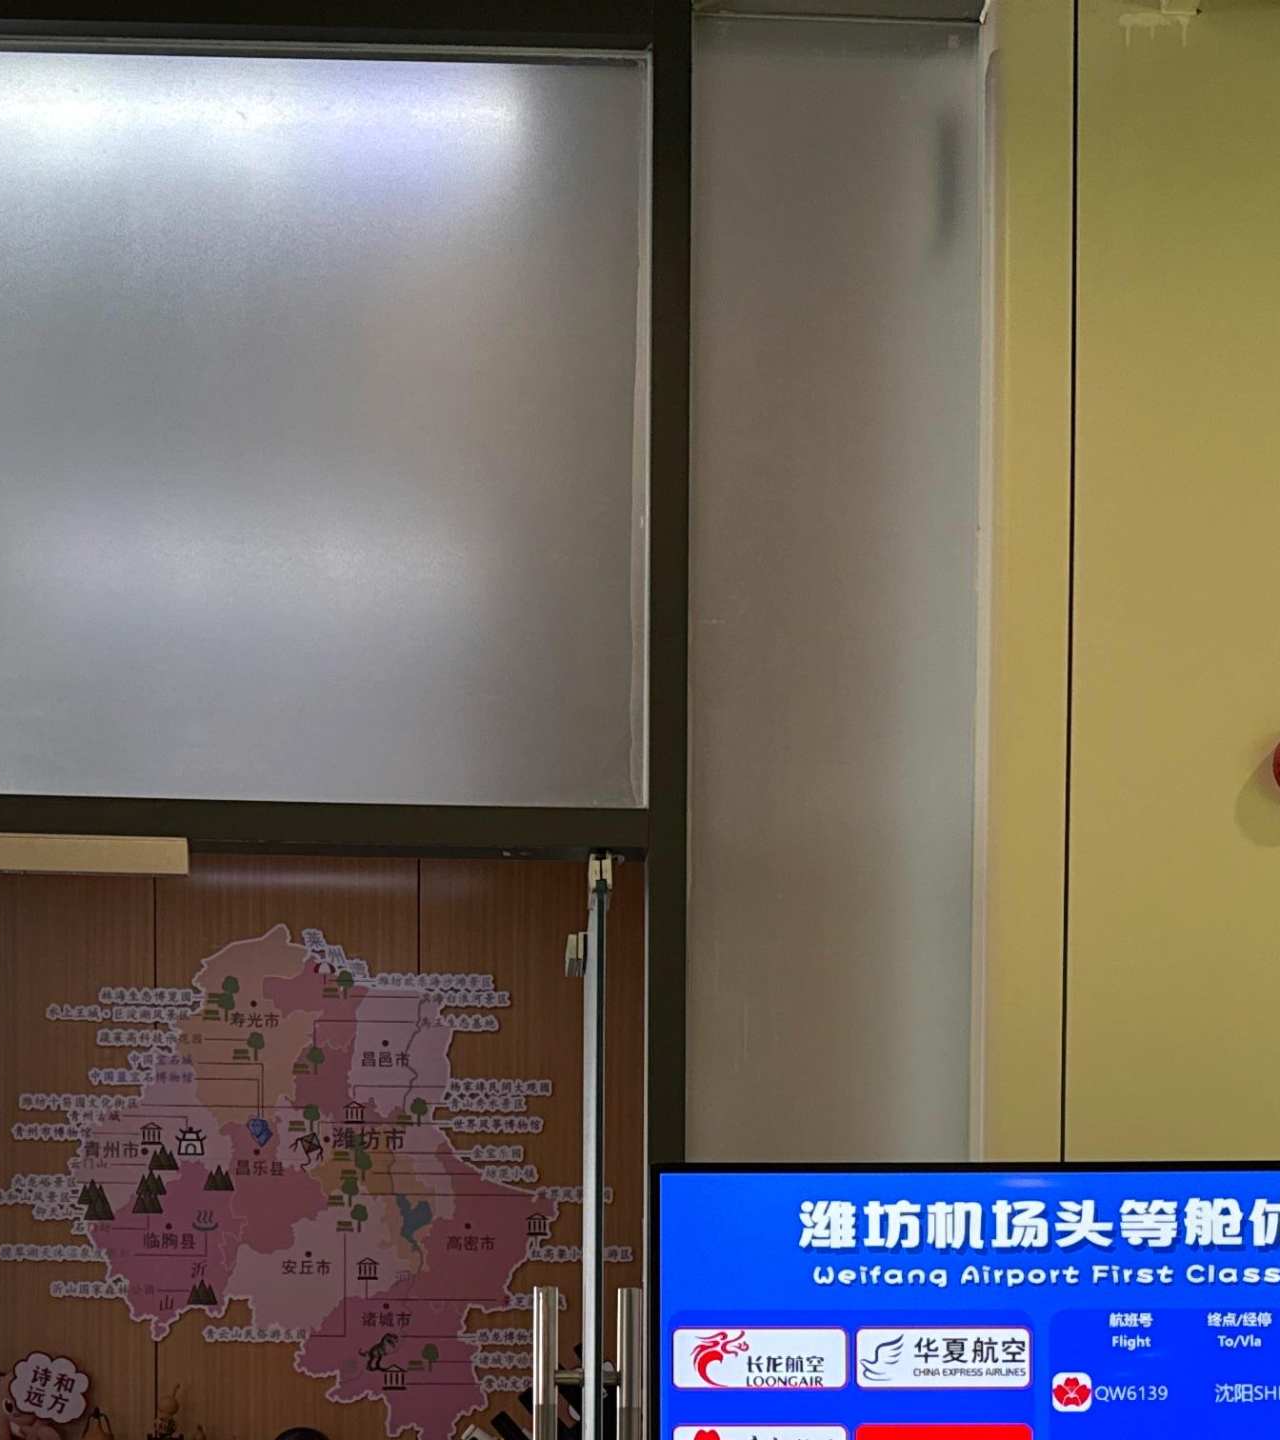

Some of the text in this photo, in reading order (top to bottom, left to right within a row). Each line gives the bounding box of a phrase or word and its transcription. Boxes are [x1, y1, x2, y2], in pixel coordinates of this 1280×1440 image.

[230, 1012, 280, 1028] 寿光市
[361, 1051, 410, 1067] 昌邑市
[332, 1126, 406, 1151] 潍坊市
[236, 1160, 284, 1176] 昌乐县
[144, 1233, 196, 1250] 临朐县
[446, 1236, 495, 1252] 高密市
[282, 1260, 332, 1275] 安丘市
[812, 1264, 949, 1287] Weifang
[959, 1264, 1080, 1287] Airport
[1092, 1263, 1174, 1285] First
[361, 1312, 411, 1327] 诸城市
[1109, 1311, 1153, 1328] 航班号
[1208, 1311, 1273, 1328] 终点/经停
[1111, 1333, 1151, 1350] Flight
[914, 1337, 1026, 1364] 华夏航空
[746, 1355, 825, 1373] 长龙航空
[913, 1367, 1027, 1377] CHINA EXPRESS AIRLINES
[31, 1365, 75, 1393] 诗和
[746, 1376, 824, 1387] LOONGAIR
[24, 1386, 69, 1414] 远方
[1094, 1384, 1169, 1403] QW6139
